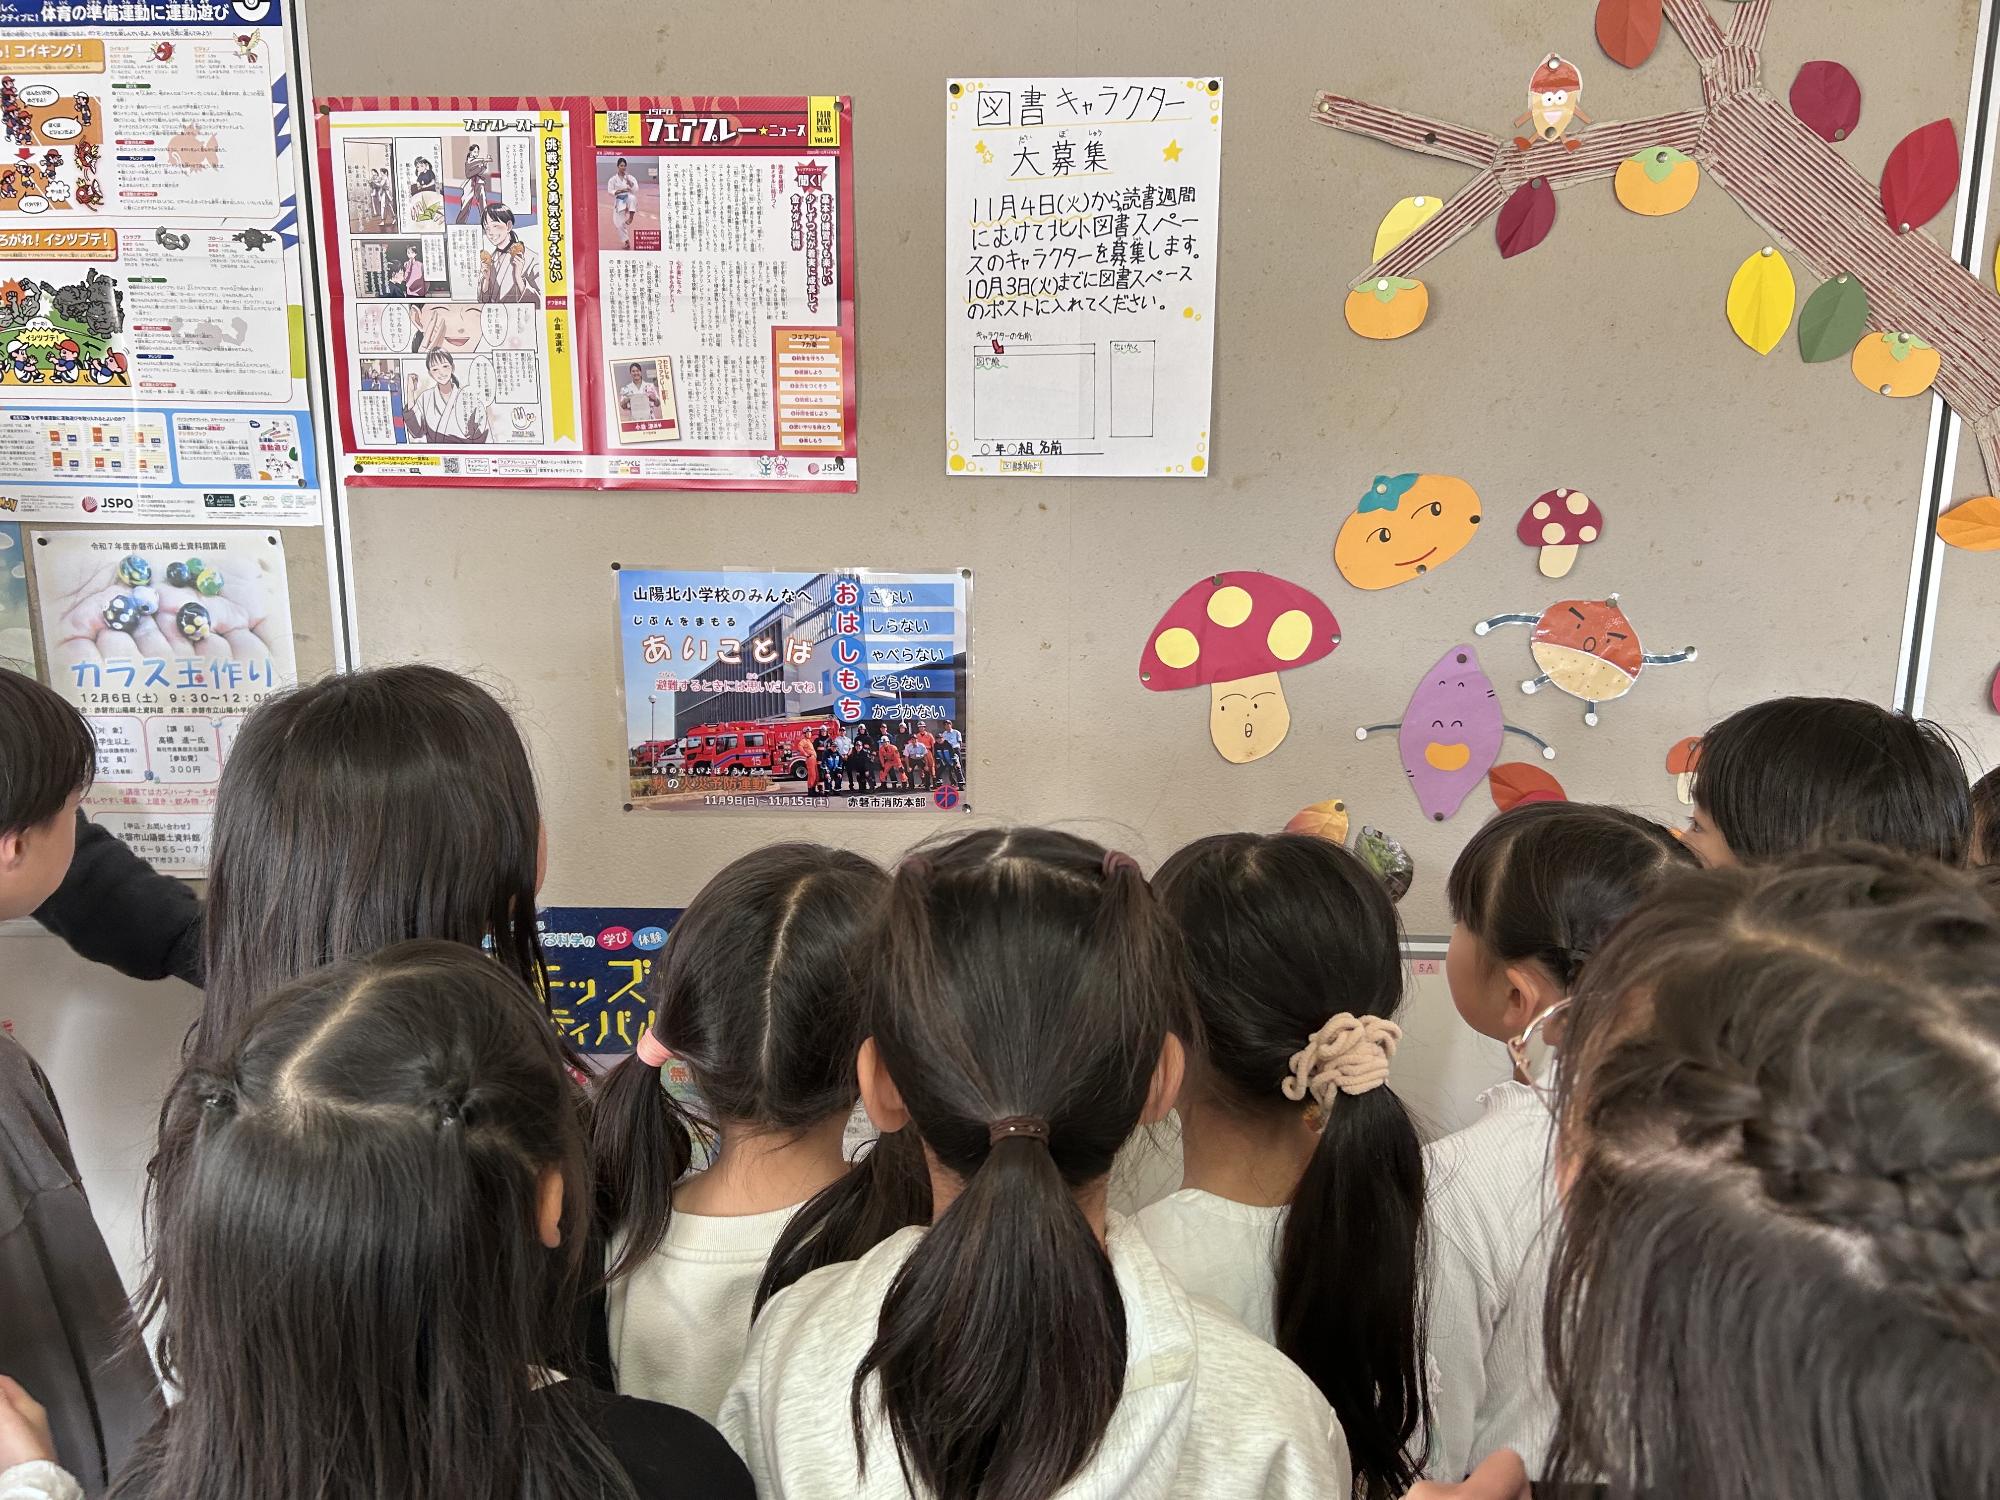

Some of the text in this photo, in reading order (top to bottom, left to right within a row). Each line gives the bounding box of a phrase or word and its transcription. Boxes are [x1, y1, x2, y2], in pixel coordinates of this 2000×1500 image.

[41, 5, 229, 22] 体育の準備運動に運動遊び
[15, 43, 83, 58] コイキング！
[977, 85, 1185, 127] 図書キャラクター
[463, 119, 564, 132] フェアプレーストーリー
[646, 118, 807, 143] フェアプレー ニュース
[816, 125, 832, 133] NEWS
[1010, 139, 1109, 177] 大募集
[544, 137, 563, 283] 挑戦する勇気を与えたい
[972, 212, 1199, 250] にむけて北小図書スペー
[44, 232, 109, 247] イシツブテ！
[966, 235, 1200, 276] スのキャラクターを募集します。
[967, 294, 1166, 320] のポストに入れてください。
[26, 334, 59, 342] イシツブテ！
[1040, 440, 1062, 455] 名前
[821, 463, 846, 472] JSPO
[101, 498, 133, 510] JSPO
[633, 586, 812, 603] 山陽北小学校のみんなへ
[633, 616, 736, 627] じぶんをまもる
[872, 618, 929, 634] しらない
[642, 635, 815, 665] あいことば
[656, 679, 824, 694] 避難するときには思いだしてね！
[872, 676, 930, 690] どらない
[872, 704, 946, 719] かづかない
[653, 778, 767, 791] 秋の火災予防運動
[847, 796, 927, 808] 赤磐市消防本部
[602, 932, 628, 947] 学び
[638, 932, 663, 946] 体験
